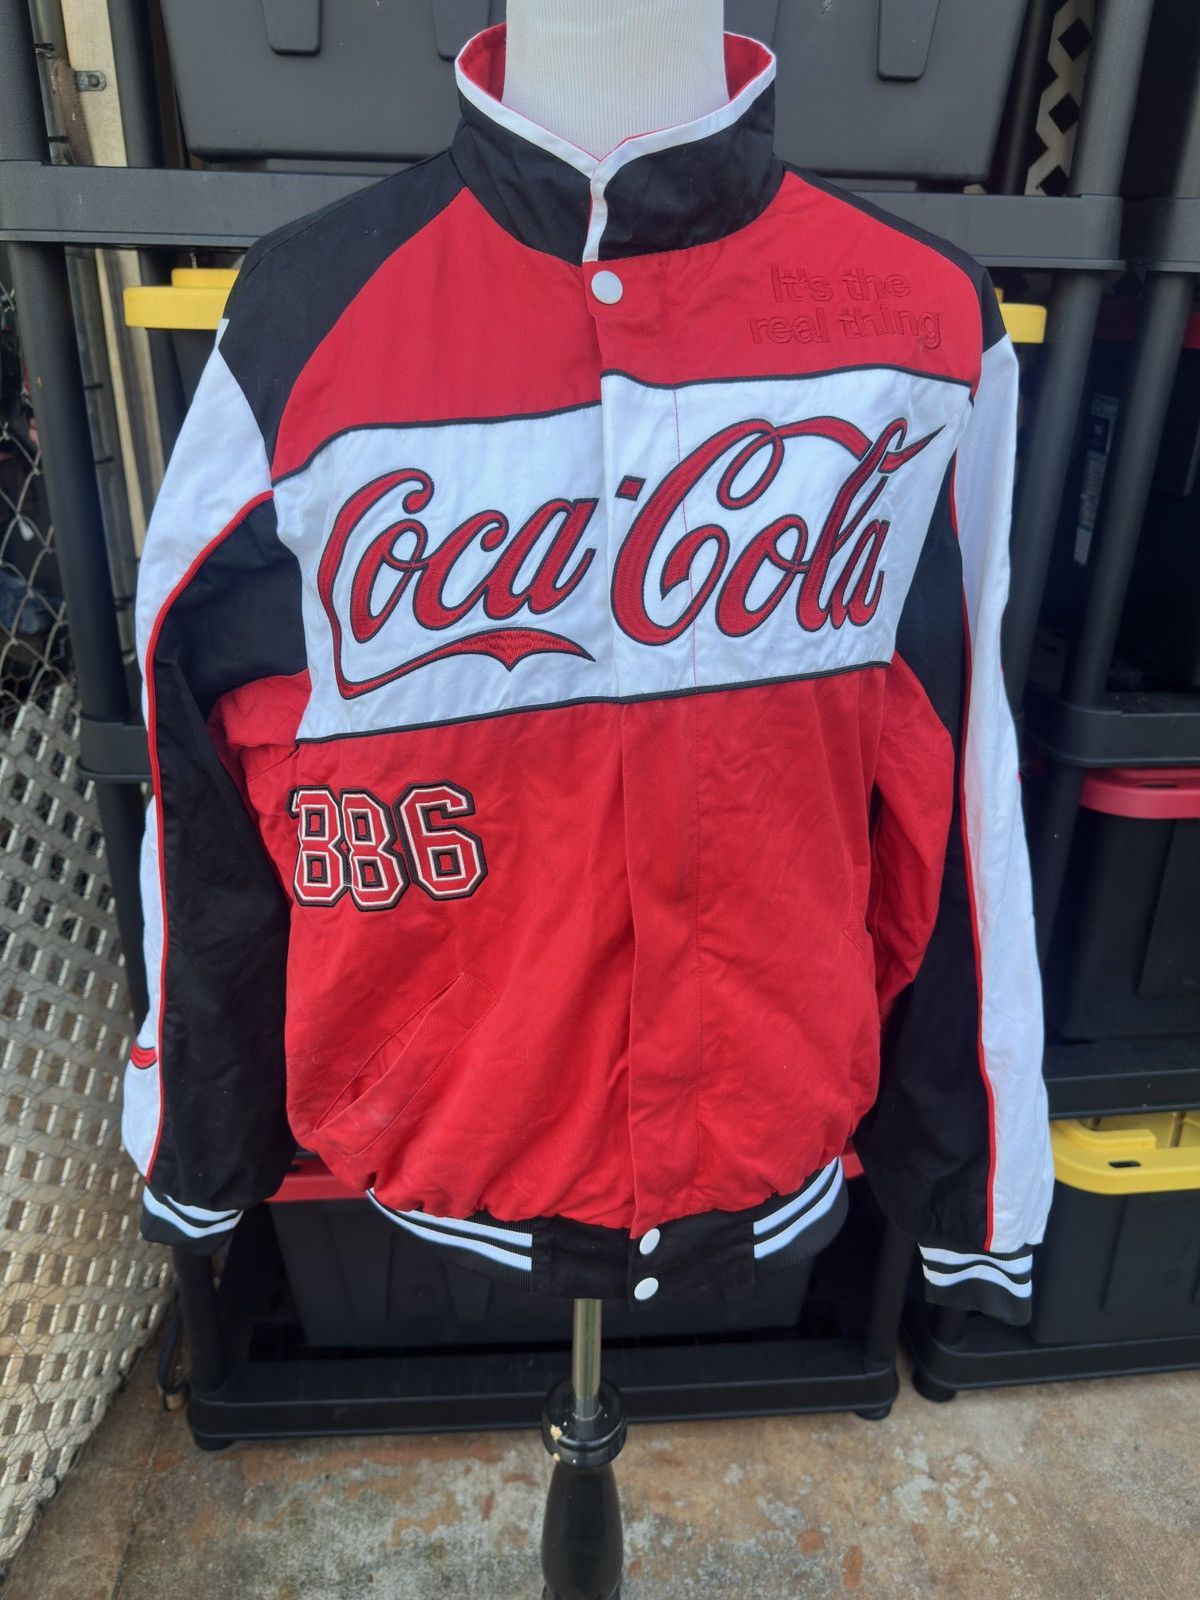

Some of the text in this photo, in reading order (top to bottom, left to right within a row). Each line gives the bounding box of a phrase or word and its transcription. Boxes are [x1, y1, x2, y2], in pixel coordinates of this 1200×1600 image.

[770, 264, 912, 303] It's the
[750, 303, 942, 350] real thing
[286, 779, 489, 912] 886
